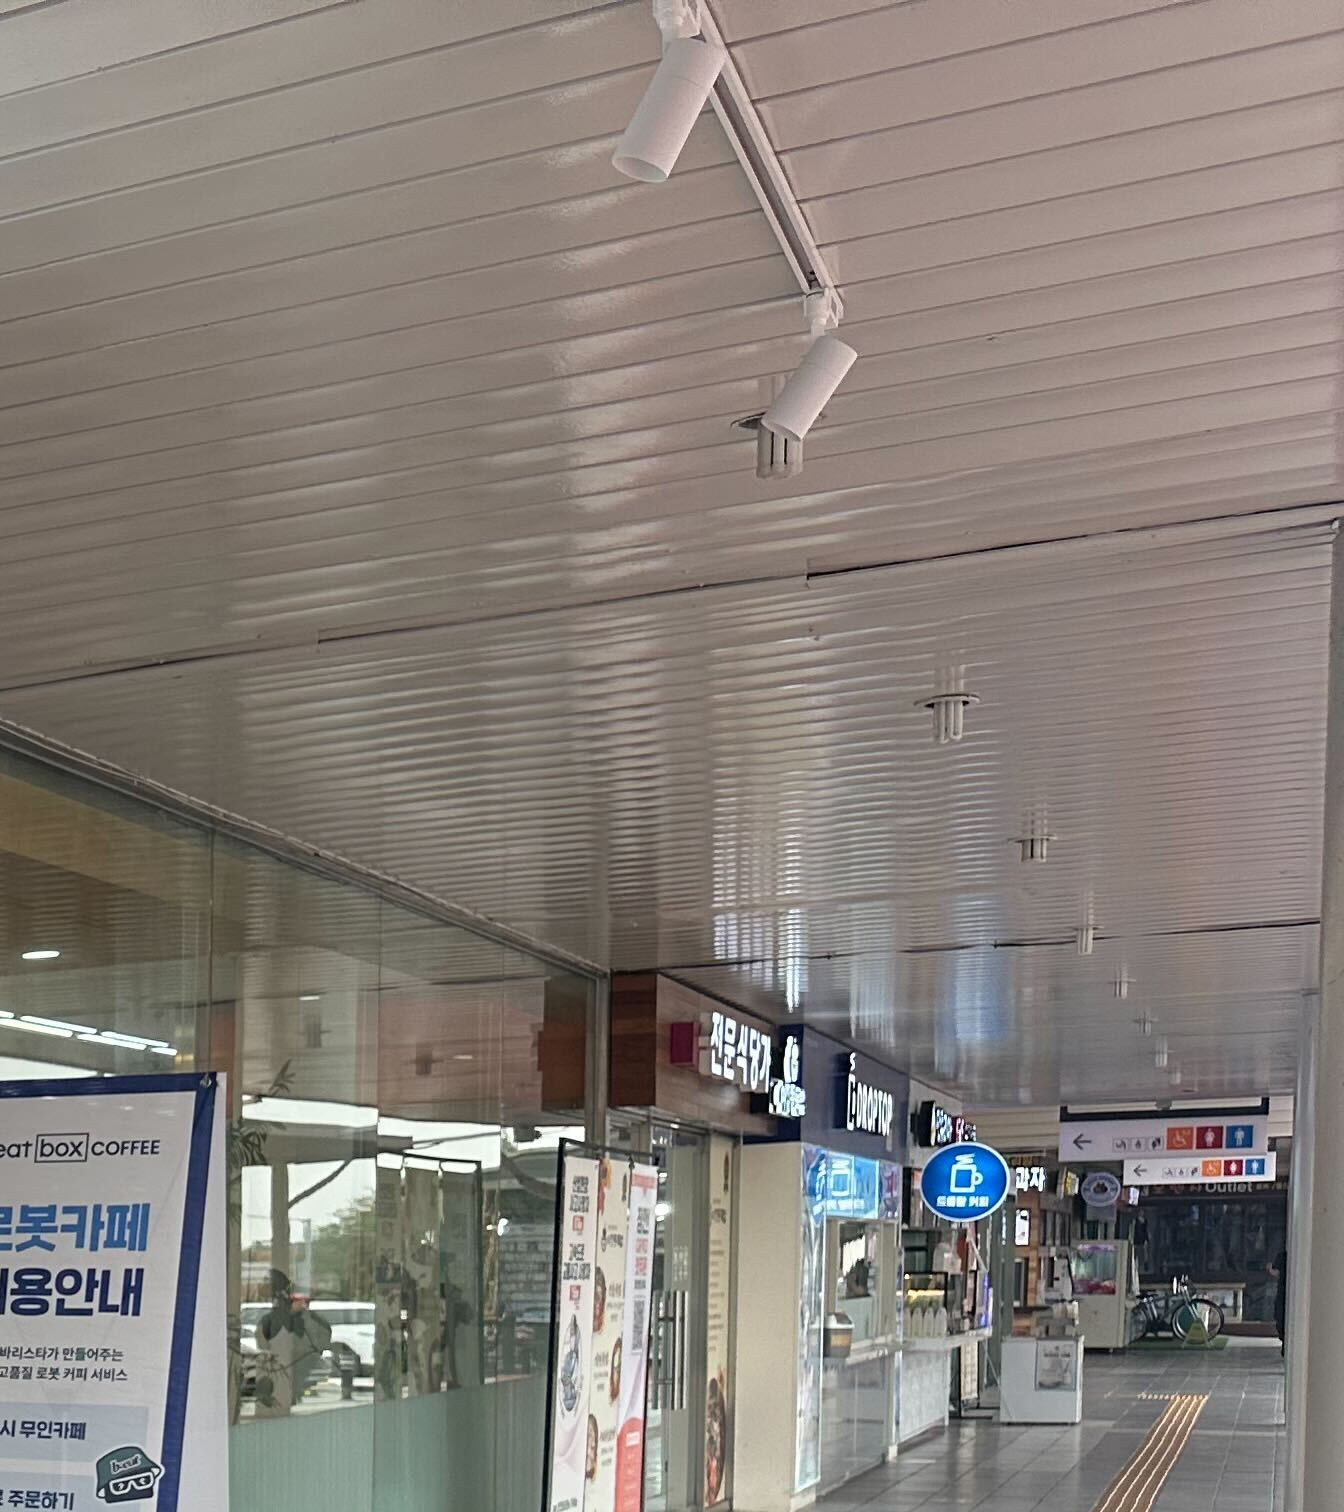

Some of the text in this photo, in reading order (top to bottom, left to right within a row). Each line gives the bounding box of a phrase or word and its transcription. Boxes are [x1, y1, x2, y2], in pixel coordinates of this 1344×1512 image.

[711, 1011, 772, 1094] 전문식당가
[855, 1081, 894, 1137] DROPTOP
[39, 1138, 84, 1158] box
[91, 1139, 161, 1156] COFFEE
[0, 1346, 59, 1361] 바리스타가
[62, 1347, 124, 1362] 만들어주는
[35, 1366, 60, 1380] 로봇
[63, 1367, 87, 1381] 커피
[90, 1368, 128, 1381] 서비스
[19, 1420, 87, 1440] 무인카페
[7, 1489, 75, 1511] 주문하기
